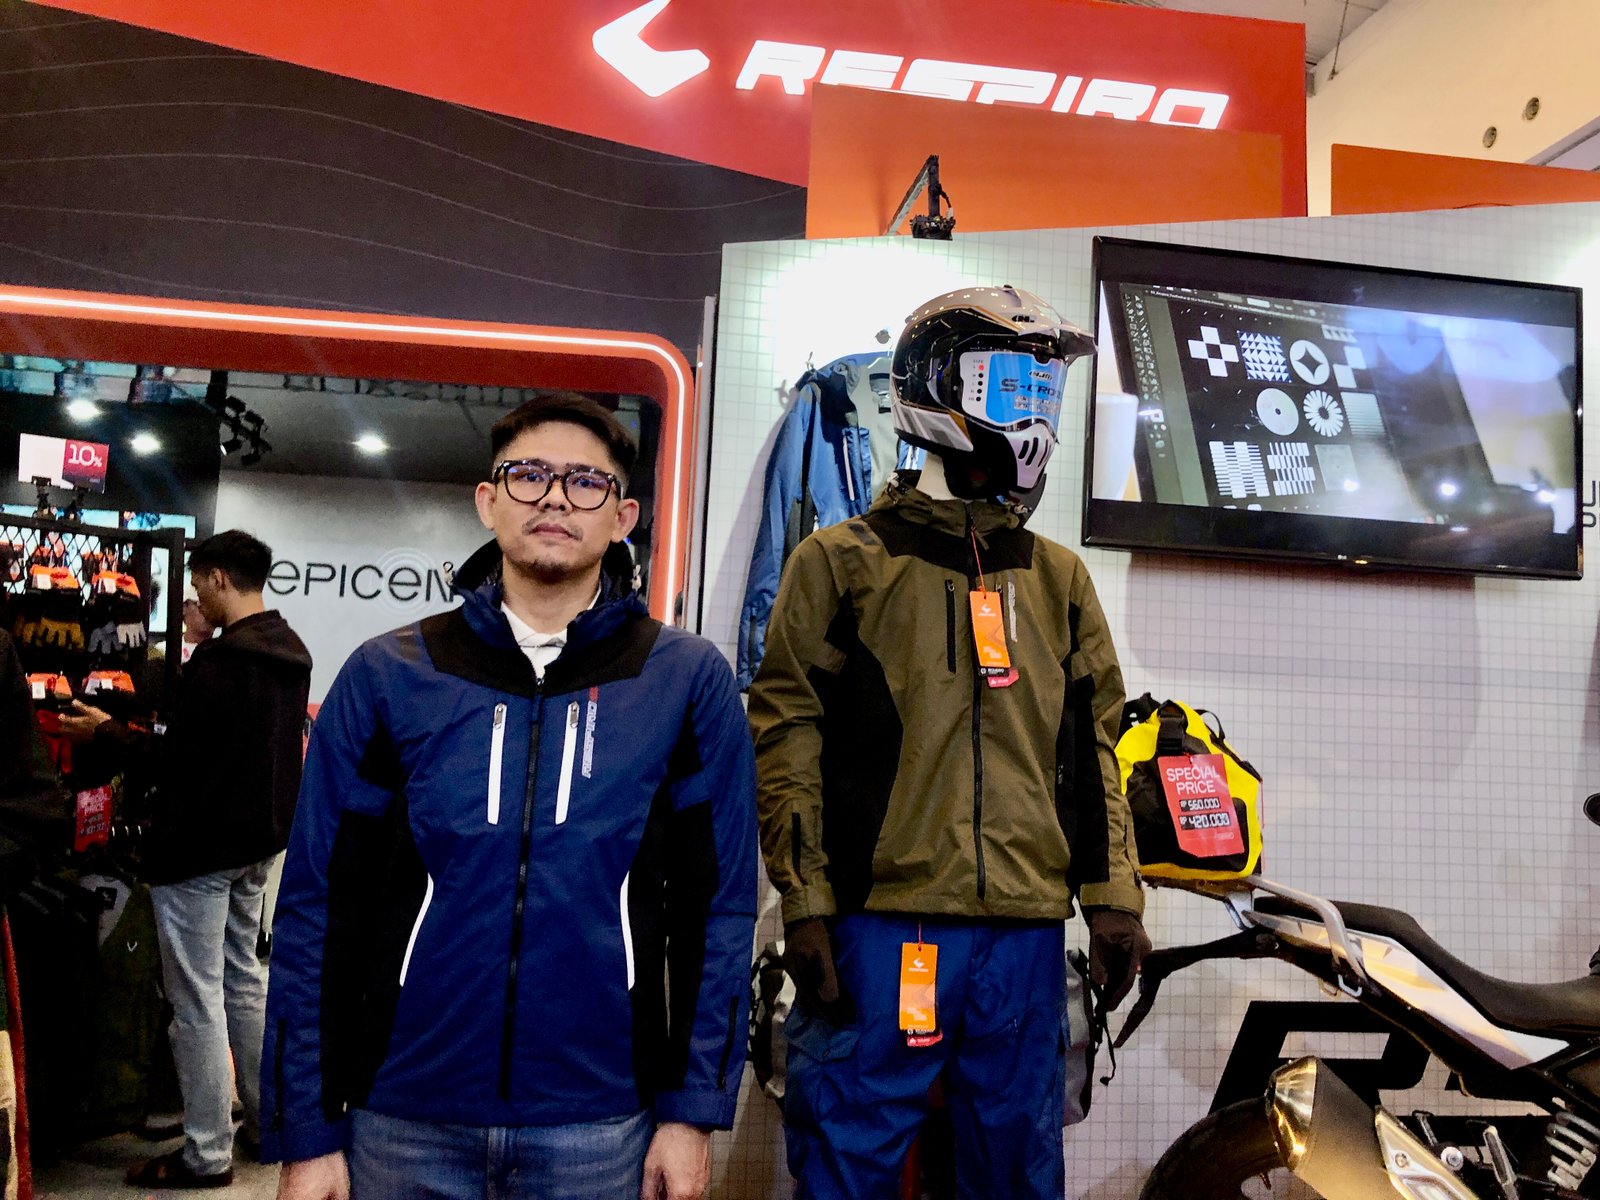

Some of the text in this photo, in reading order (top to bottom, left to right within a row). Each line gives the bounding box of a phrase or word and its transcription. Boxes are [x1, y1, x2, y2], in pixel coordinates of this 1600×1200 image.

[735, 40, 1230, 129] RESPIRO
[1166, 766, 1220, 782] SPECIAL
[1176, 780, 1216, 795] PRICE
[1188, 798, 1220, 811] 560.000
[1188, 812, 1230, 829] 420.000
